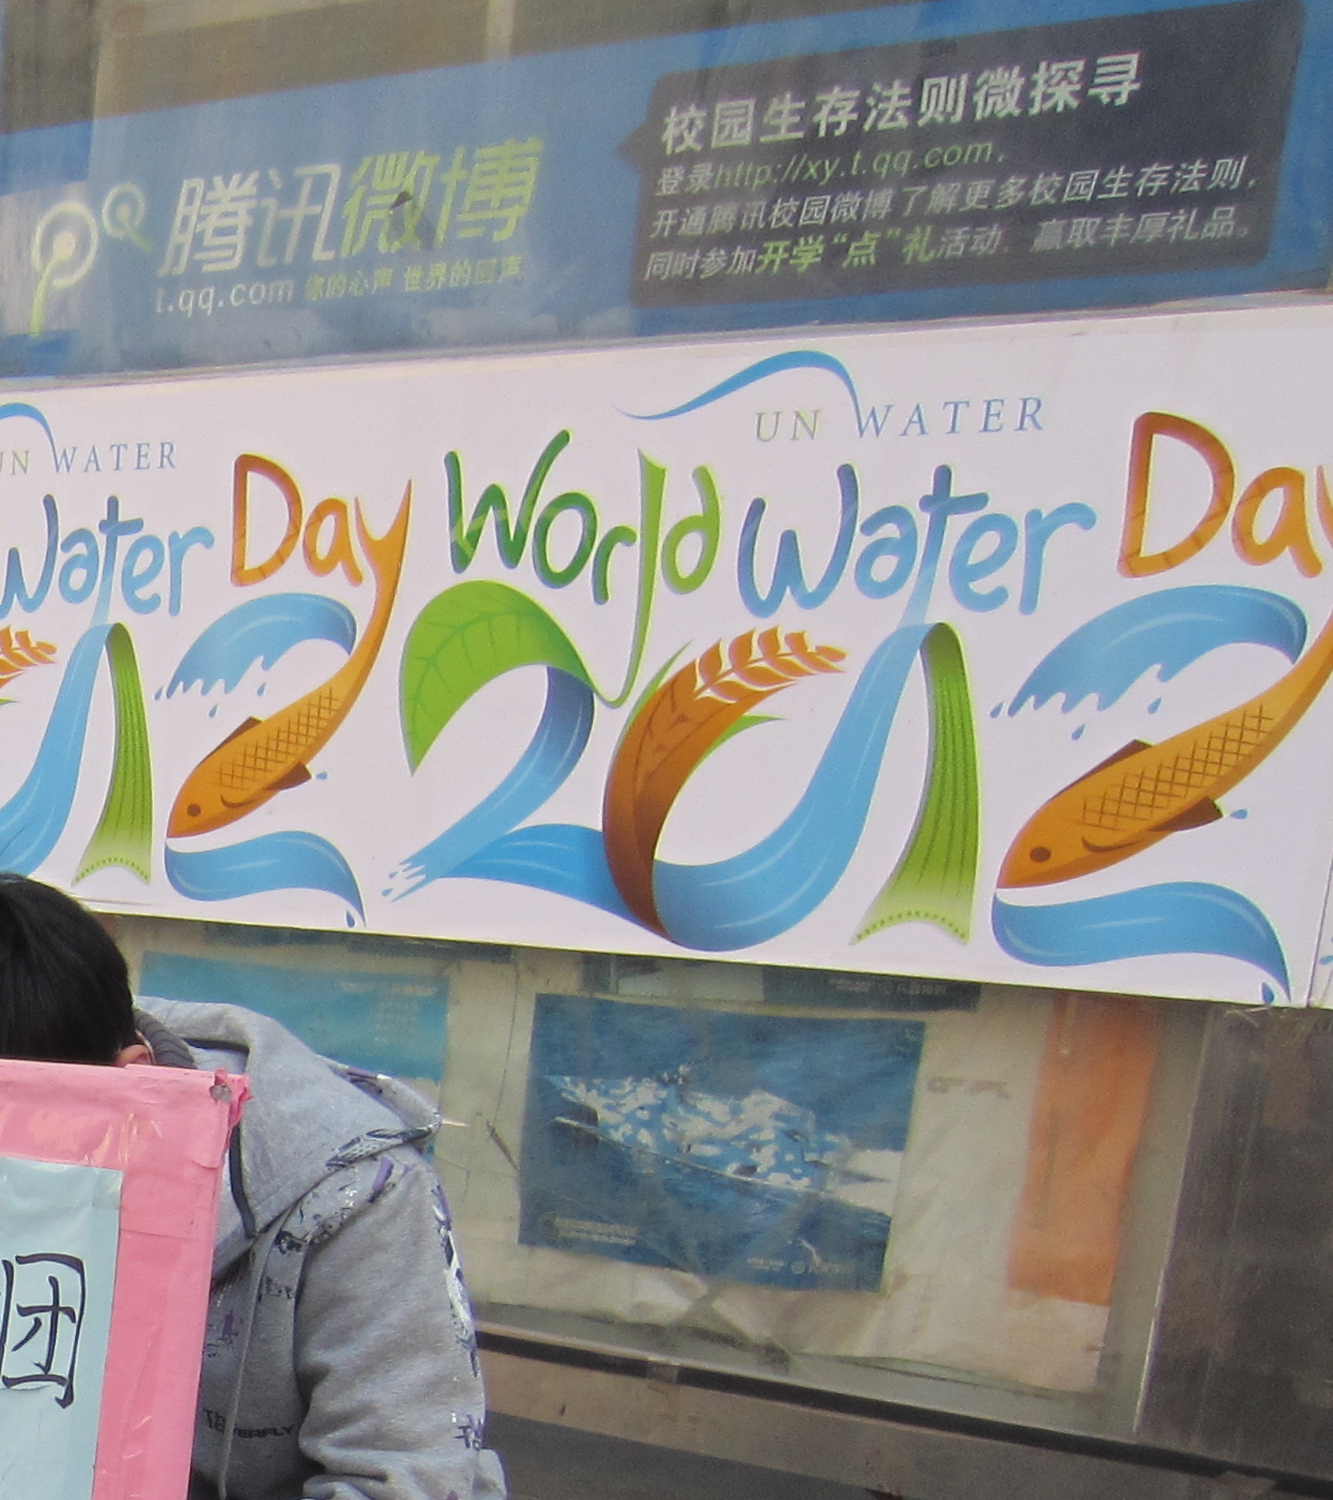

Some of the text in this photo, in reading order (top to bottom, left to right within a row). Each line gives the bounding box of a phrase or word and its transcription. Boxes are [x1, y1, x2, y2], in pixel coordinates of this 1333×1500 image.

[661, 51, 1142, 155] 校园生存法则微探寻
[158, 137, 545, 277] 腾讯微博
[155, 279, 293, 317] t.qq.com
[403, 254, 524, 293] 世界的回声
[51, 440, 179, 474] WATER
[754, 397, 1046, 444] UN WATER
[230, 452, 414, 590] Day
[443, 430, 720, 708] World
[736, 464, 1095, 619] Water
